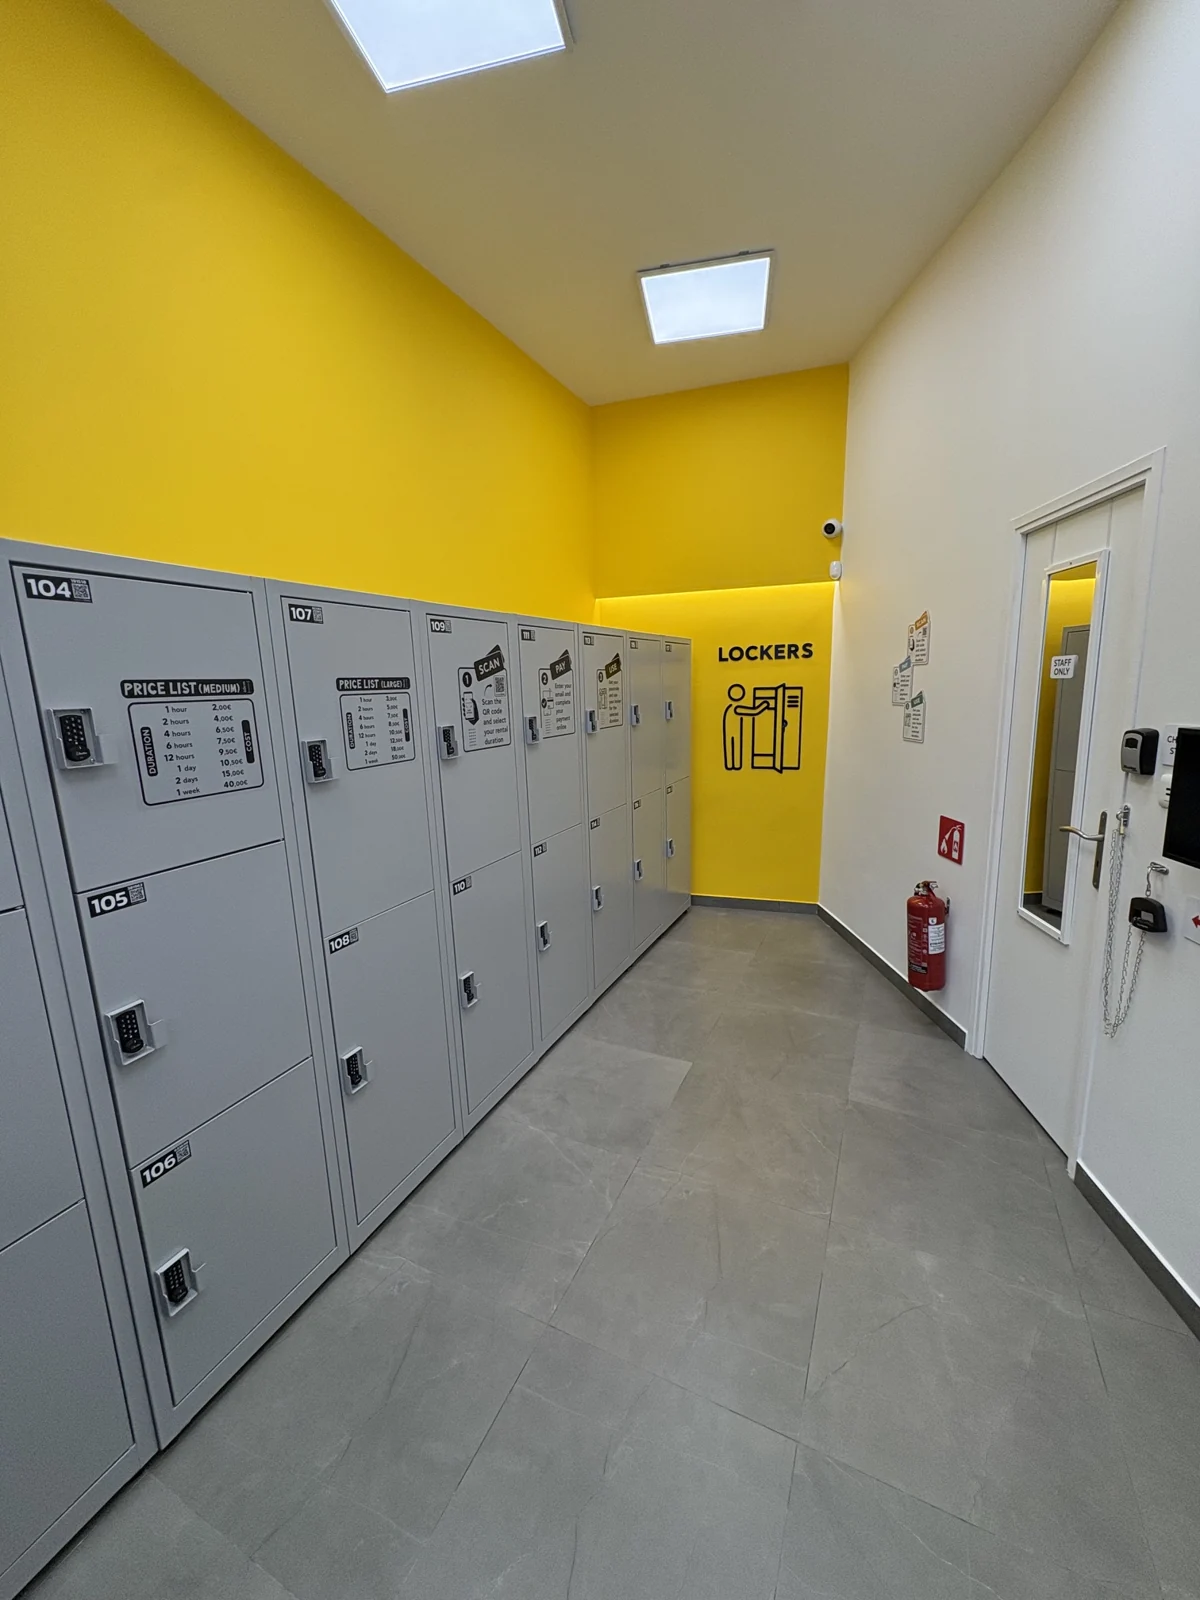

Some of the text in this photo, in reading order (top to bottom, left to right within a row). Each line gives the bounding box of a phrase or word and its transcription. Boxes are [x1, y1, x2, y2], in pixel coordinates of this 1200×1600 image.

[26, 578, 72, 598] 104
[290, 607, 312, 620] 107
[431, 621, 445, 631] 109
[718, 642, 813, 662] LOCKERS
[478, 657, 501, 675] SCAN
[555, 661, 566, 674] PAY
[1054, 658, 1072, 667] STAFF
[124, 682, 165, 696] PRICE
[169, 682, 196, 694] LIST
[198, 683, 240, 694] (MEDIUM)
[339, 679, 362, 690] PRICE
[364, 679, 379, 689] LIST
[381, 680, 403, 689] (LARGE)
[482, 708, 490, 716] QR
[483, 718, 492, 726] and
[164, 730, 170, 738] 4
[216, 726, 235, 734] 6,50€
[484, 726, 508, 737] your rental
[166, 742, 172, 750] 6
[217, 737, 235, 745] 7,50€
[244, 732, 252, 752] COST
[484, 737, 504, 745] duration
[142, 729, 157, 775] DURATION
[164, 748, 237, 762] 12 hours 9,50€
[184, 765, 196, 773] day
[220, 759, 243, 767] 10,50€
[182, 776, 198, 784] days
[222, 769, 244, 777] 15,00€
[176, 780, 248, 796] 1 week 40,00€
[454, 881, 465, 893] 110
[91, 891, 128, 914] 105
[330, 934, 350, 951] 108
[143, 1154, 176, 1183] 106
